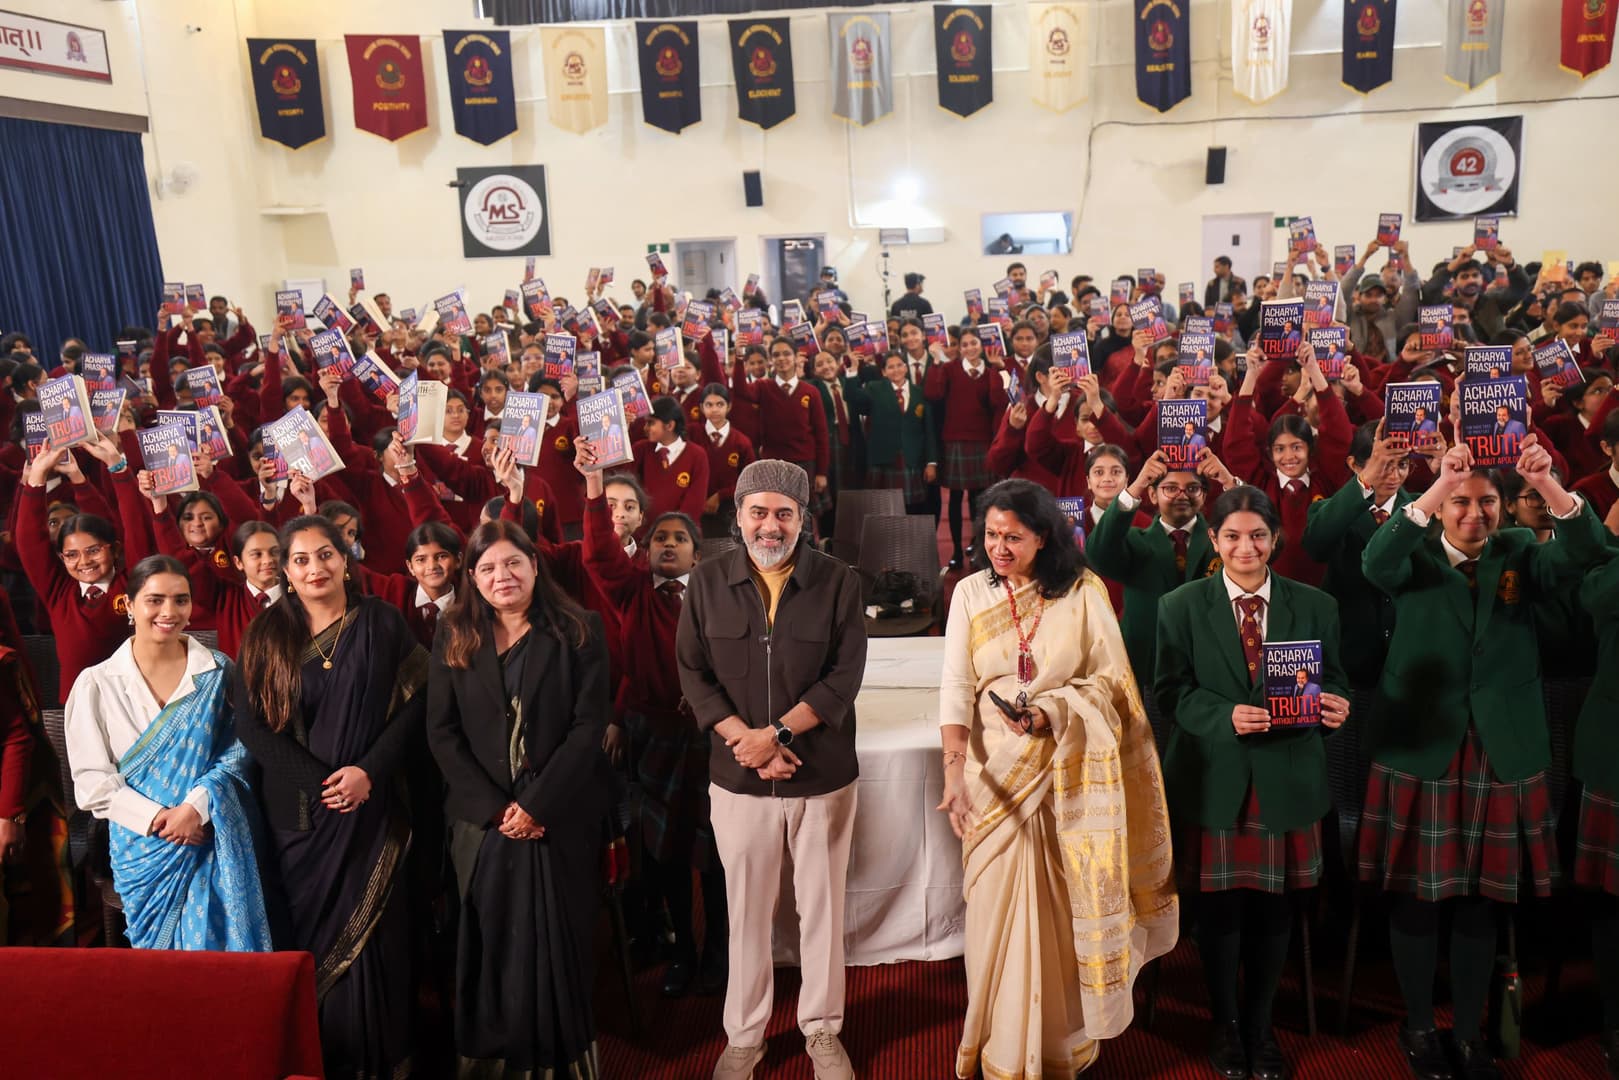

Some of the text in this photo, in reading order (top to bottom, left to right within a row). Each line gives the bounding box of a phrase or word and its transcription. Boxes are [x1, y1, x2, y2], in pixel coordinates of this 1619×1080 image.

[1456, 157, 1476, 172] 42
[489, 204, 520, 220] MS
[1307, 284, 1332, 292] ACHARYA
[1130, 301, 1154, 314] ACHARYA
[1265, 307, 1298, 317] ACHARYA
[1421, 308, 1448, 316] ACHARYA
[1264, 316, 1302, 326] PRASHANT
[312, 334, 337, 347] ACHARYA
[1053, 336, 1081, 346] ACHARYA
[1181, 335, 1210, 344] ACHARYA
[1311, 330, 1340, 340] ACHARYA
[1421, 333, 1452, 345] TRUTH
[547, 337, 571, 347] ACHARYA
[1263, 338, 1300, 353] TRUTH
[1311, 340, 1344, 348] PRASHANT
[1054, 343, 1086, 355] PRASHANT
[1181, 345, 1213, 353] PRASHANT
[1535, 345, 1562, 361] ACHARYA
[85, 355, 112, 364] ACHARYA
[1468, 351, 1506, 362] ACHARYA
[1538, 350, 1569, 368] PRASHANT
[1316, 359, 1345, 373] RUTH
[1468, 362, 1511, 372] PRASHANT
[1551, 370, 1579, 386] RUTH
[40, 380, 70, 399] ACHARYA
[1392, 390, 1433, 402] ACHARYA
[1464, 384, 1516, 400] ACHARYA
[42, 389, 76, 410] PRASHANT
[507, 397, 538, 408] ACHARYA
[580, 395, 612, 416] ACHARYA
[1161, 405, 1200, 416] ACHARYA
[1391, 401, 1438, 414] PRASHANT
[1465, 397, 1524, 416] PRASHANT
[26, 415, 44, 425] ACHA
[506, 407, 540, 420] PRASHANT
[581, 405, 618, 426] PRASHANT
[159, 416, 191, 426] ACHARYA
[273, 412, 303, 437] ACHARYA
[1161, 416, 1205, 428] PRASHANT
[26, 424, 46, 433] PRAS
[48, 416, 85, 440] TRUTH
[277, 420, 312, 449] PRASHANT
[142, 428, 180, 444] ACHARYA
[144, 436, 186, 455] PRASHANT
[501, 434, 534, 452] TRUTH
[1466, 432, 1524, 457] TRUTH
[152, 464, 190, 484] TRUTH
[1267, 649, 1314, 663] ACHARYA
[1268, 662, 1320, 677] PRASHANT
[1268, 694, 1321, 716] TRUTH
